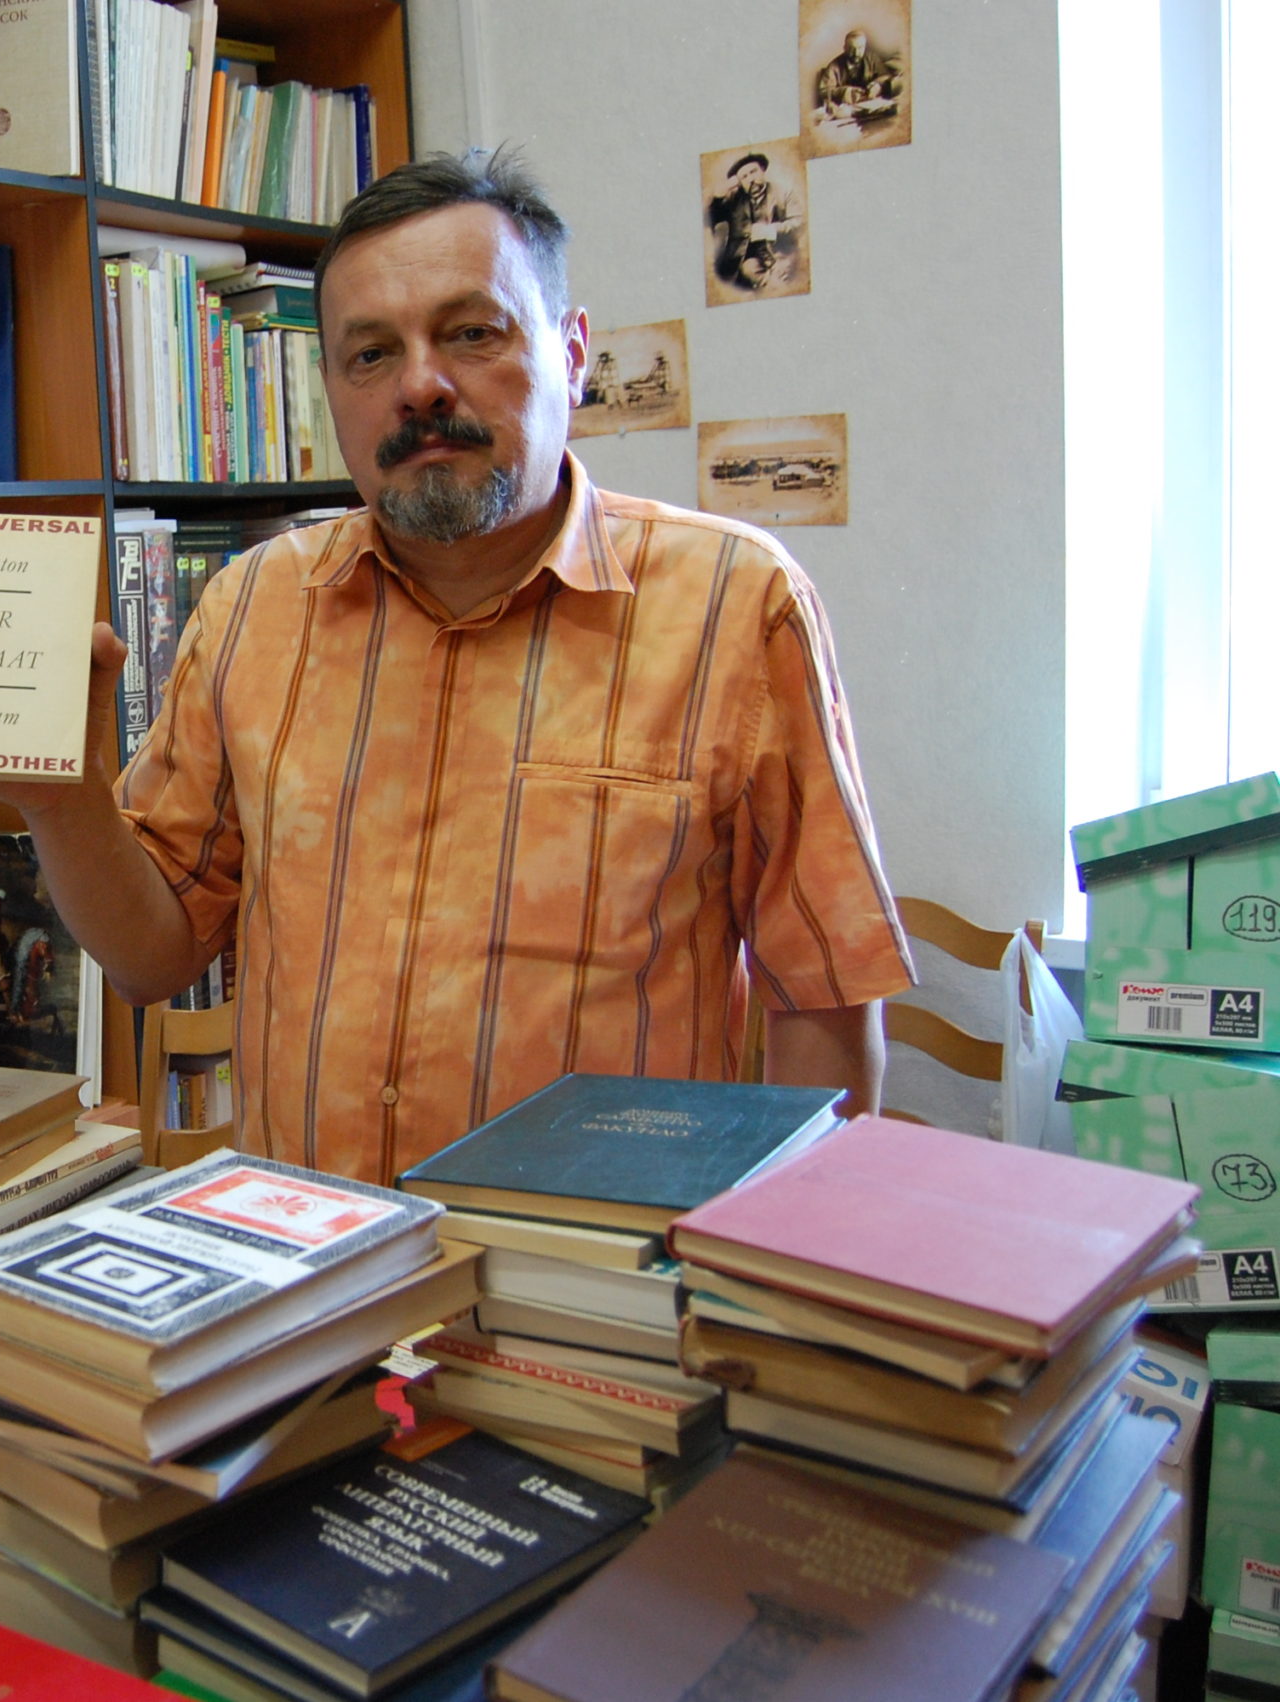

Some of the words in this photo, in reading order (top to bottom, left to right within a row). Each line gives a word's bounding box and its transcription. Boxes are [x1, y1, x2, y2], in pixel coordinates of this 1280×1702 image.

[1170, 992, 1204, 1001] premium
[1219, 993, 1253, 1013] A4
[1222, 1163, 1268, 1193] 73
[1234, 1254, 1268, 1275] A4
[374, 1464, 540, 1547] СОВРЕМЕННЫЙ
[384, 1487, 488, 1541] РУССКИЙ
[337, 1483, 505, 1568] ЛИТЕРАТУРНЫЙ
[364, 1515, 431, 1551] ЯЗЫК
